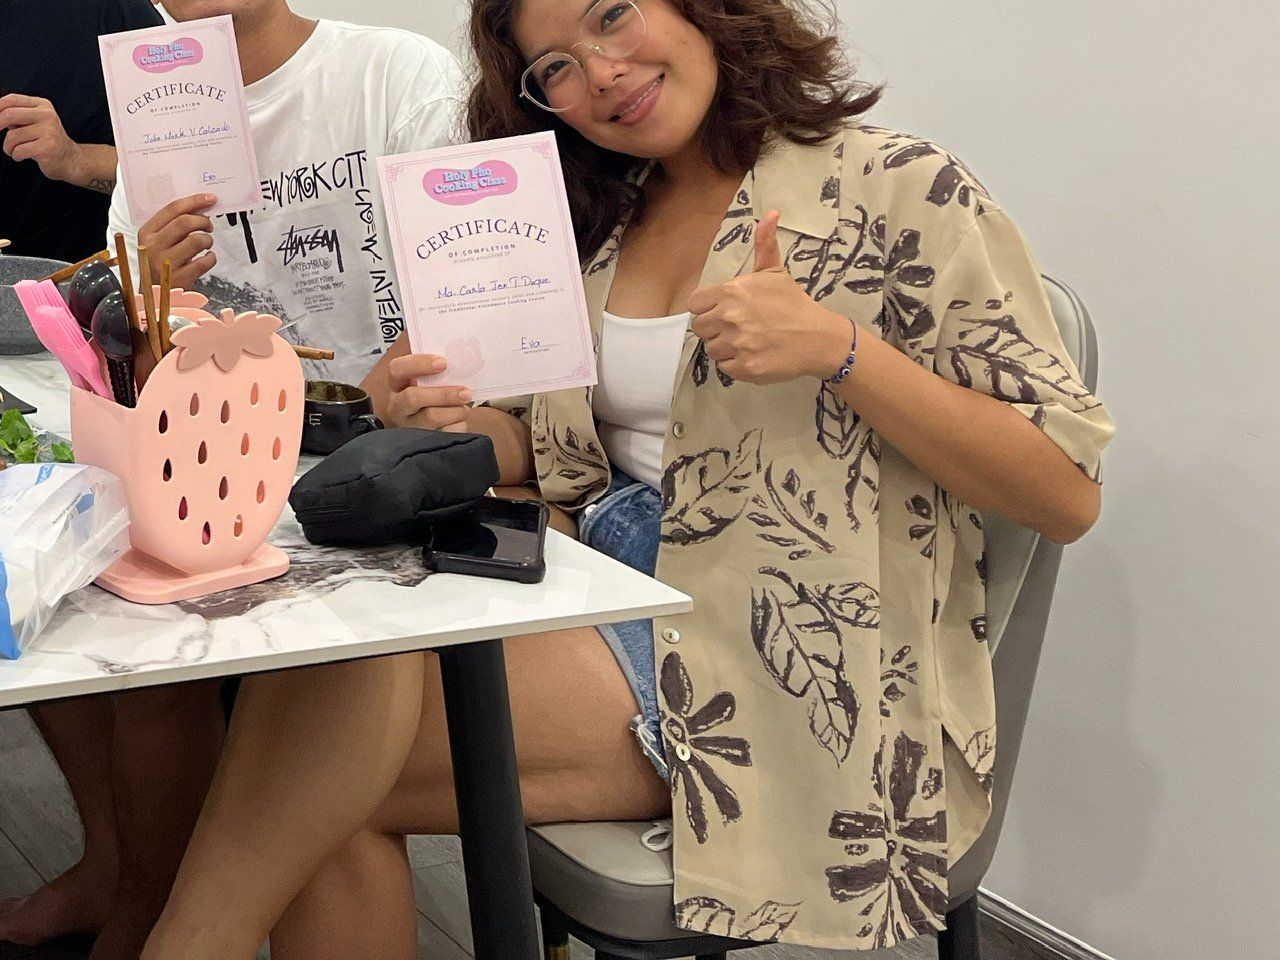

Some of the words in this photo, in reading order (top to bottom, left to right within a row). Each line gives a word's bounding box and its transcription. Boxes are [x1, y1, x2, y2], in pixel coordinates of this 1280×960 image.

[140, 53, 173, 66] Cooking
[126, 82, 227, 115] CERTIFICATE
[160, 102, 201, 112] COMPLETION
[286, 161, 333, 204] YORK
[332, 149, 367, 189] CIT
[443, 171, 468, 183] Holy
[470, 168, 491, 178] Pho
[434, 180, 478, 194] Cooking
[479, 176, 507, 187] Class
[416, 218, 549, 260] CERTIFICATE
[462, 243, 516, 256] COMPLETION
